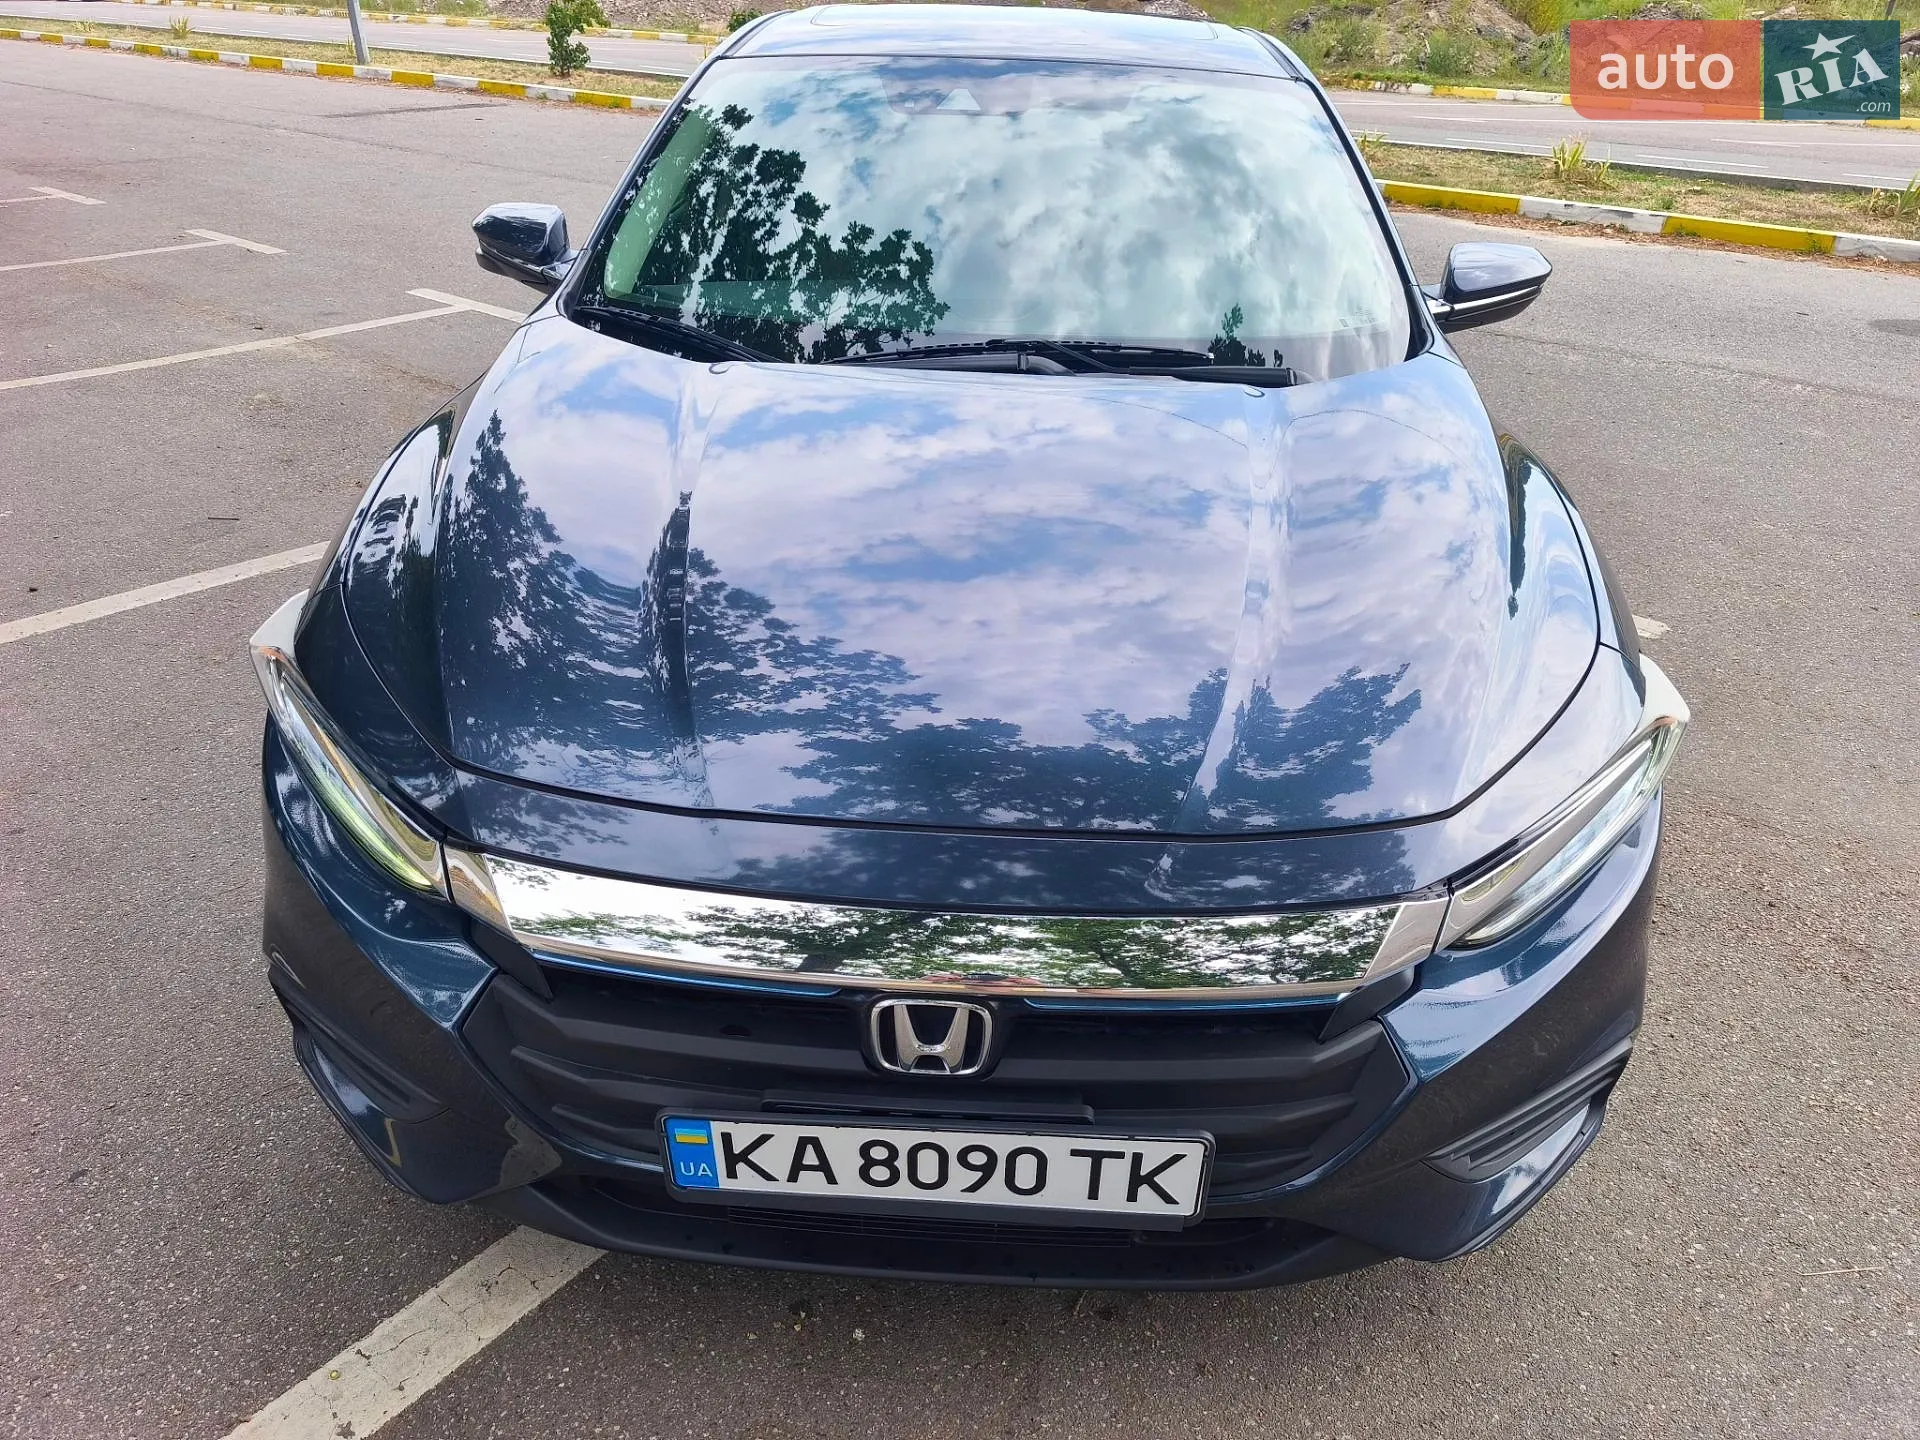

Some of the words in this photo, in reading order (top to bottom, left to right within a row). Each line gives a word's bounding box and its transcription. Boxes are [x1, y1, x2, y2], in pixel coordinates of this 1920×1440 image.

[680, 1161, 714, 1178] UA
[720, 1131, 839, 1186] KA
[858, 1139, 1048, 1197] 8090
[1069, 1147, 1188, 1206] TK
